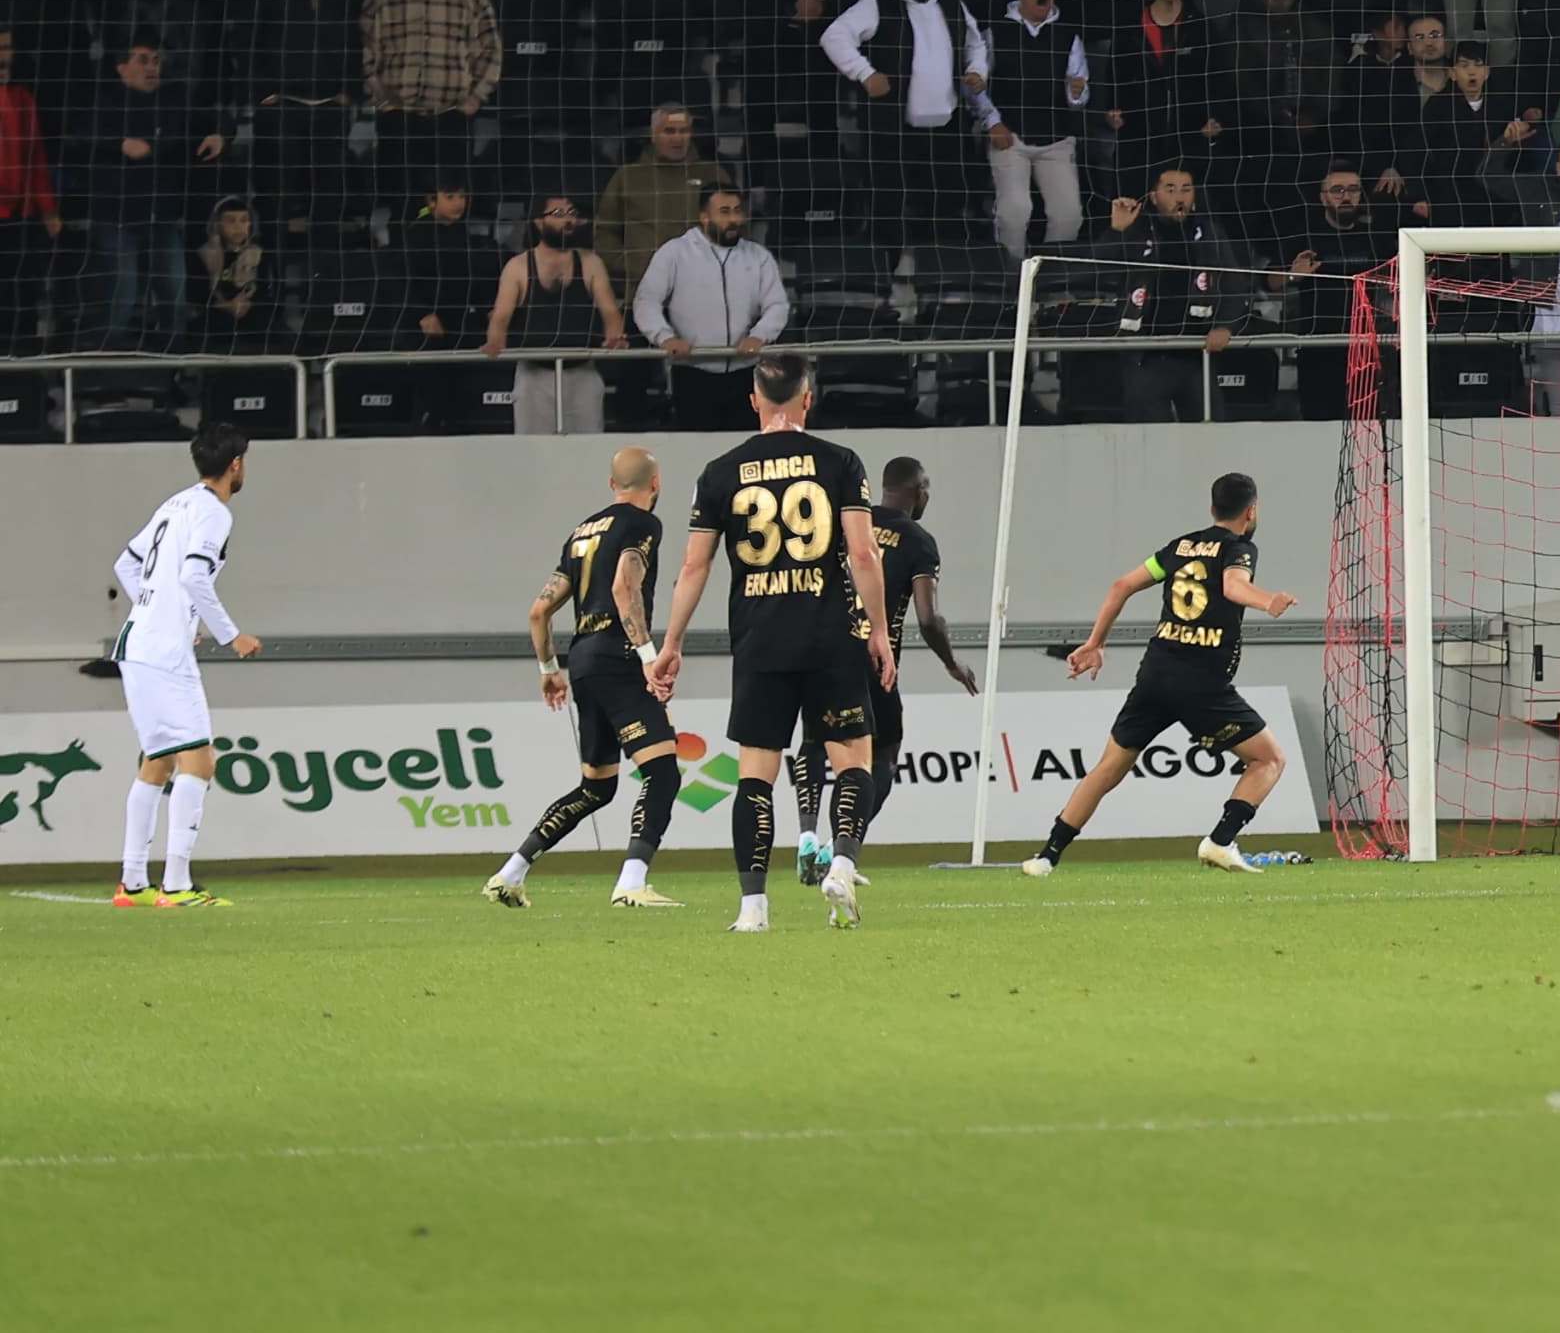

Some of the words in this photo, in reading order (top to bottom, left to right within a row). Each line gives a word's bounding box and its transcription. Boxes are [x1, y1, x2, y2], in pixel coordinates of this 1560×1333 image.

[762, 454, 818, 481] ARCA
[144, 517, 170, 581] 8
[731, 479, 834, 568] 39
[570, 534, 603, 607] 7
[743, 571, 789, 598] ERKAN
[790, 567, 825, 598] KAŞ
[1171, 559, 1209, 622] 6
[200, 725, 504, 813] öyceli
[399, 794, 511, 829] Yem
